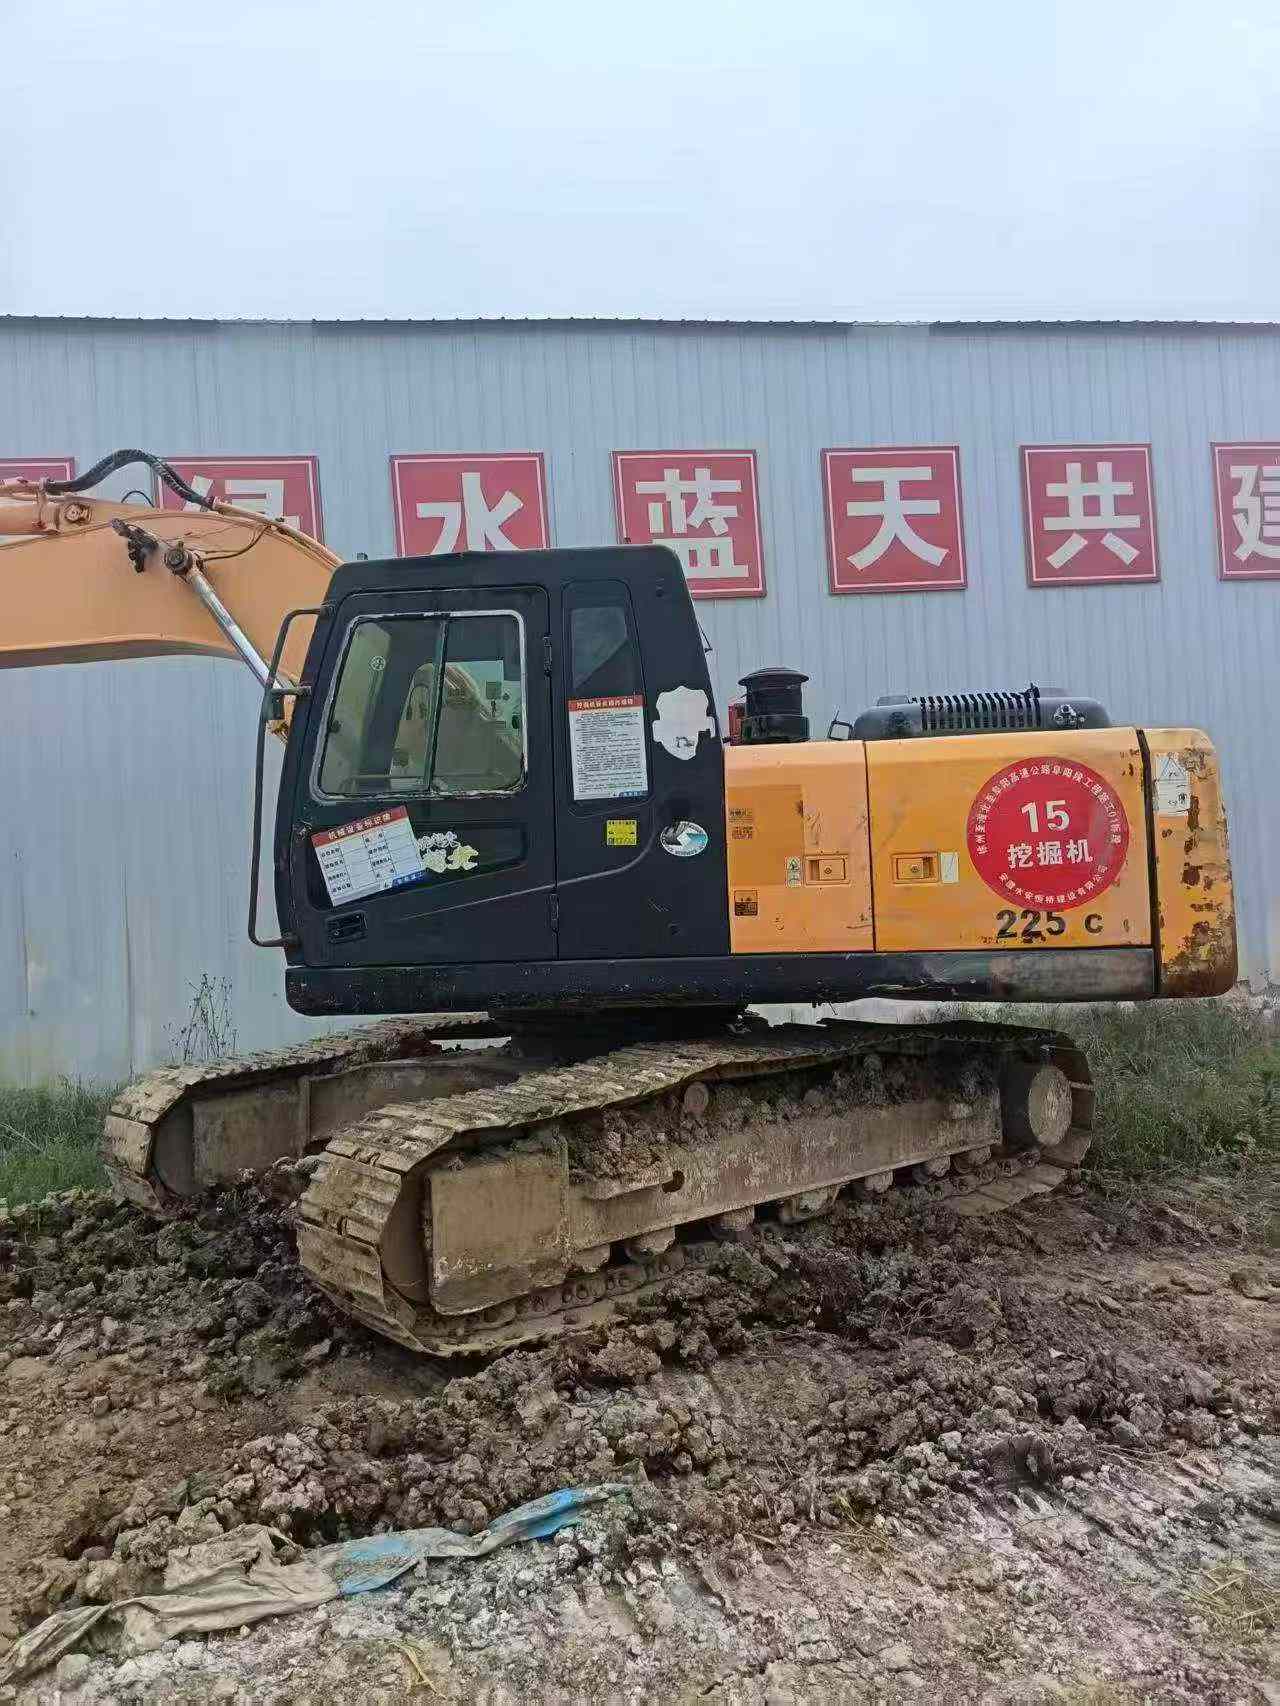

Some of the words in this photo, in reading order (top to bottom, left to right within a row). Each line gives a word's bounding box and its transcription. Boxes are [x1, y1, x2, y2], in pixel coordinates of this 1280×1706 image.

[416, 472, 524, 555] 水
[636, 468, 749, 579] 蓝
[847, 466, 949, 571] 天
[1043, 461, 1141, 568] 共
[1021, 799, 1070, 832] 15
[1007, 839, 1094, 869] 挖掘机
[996, 909, 1066, 939] 225
